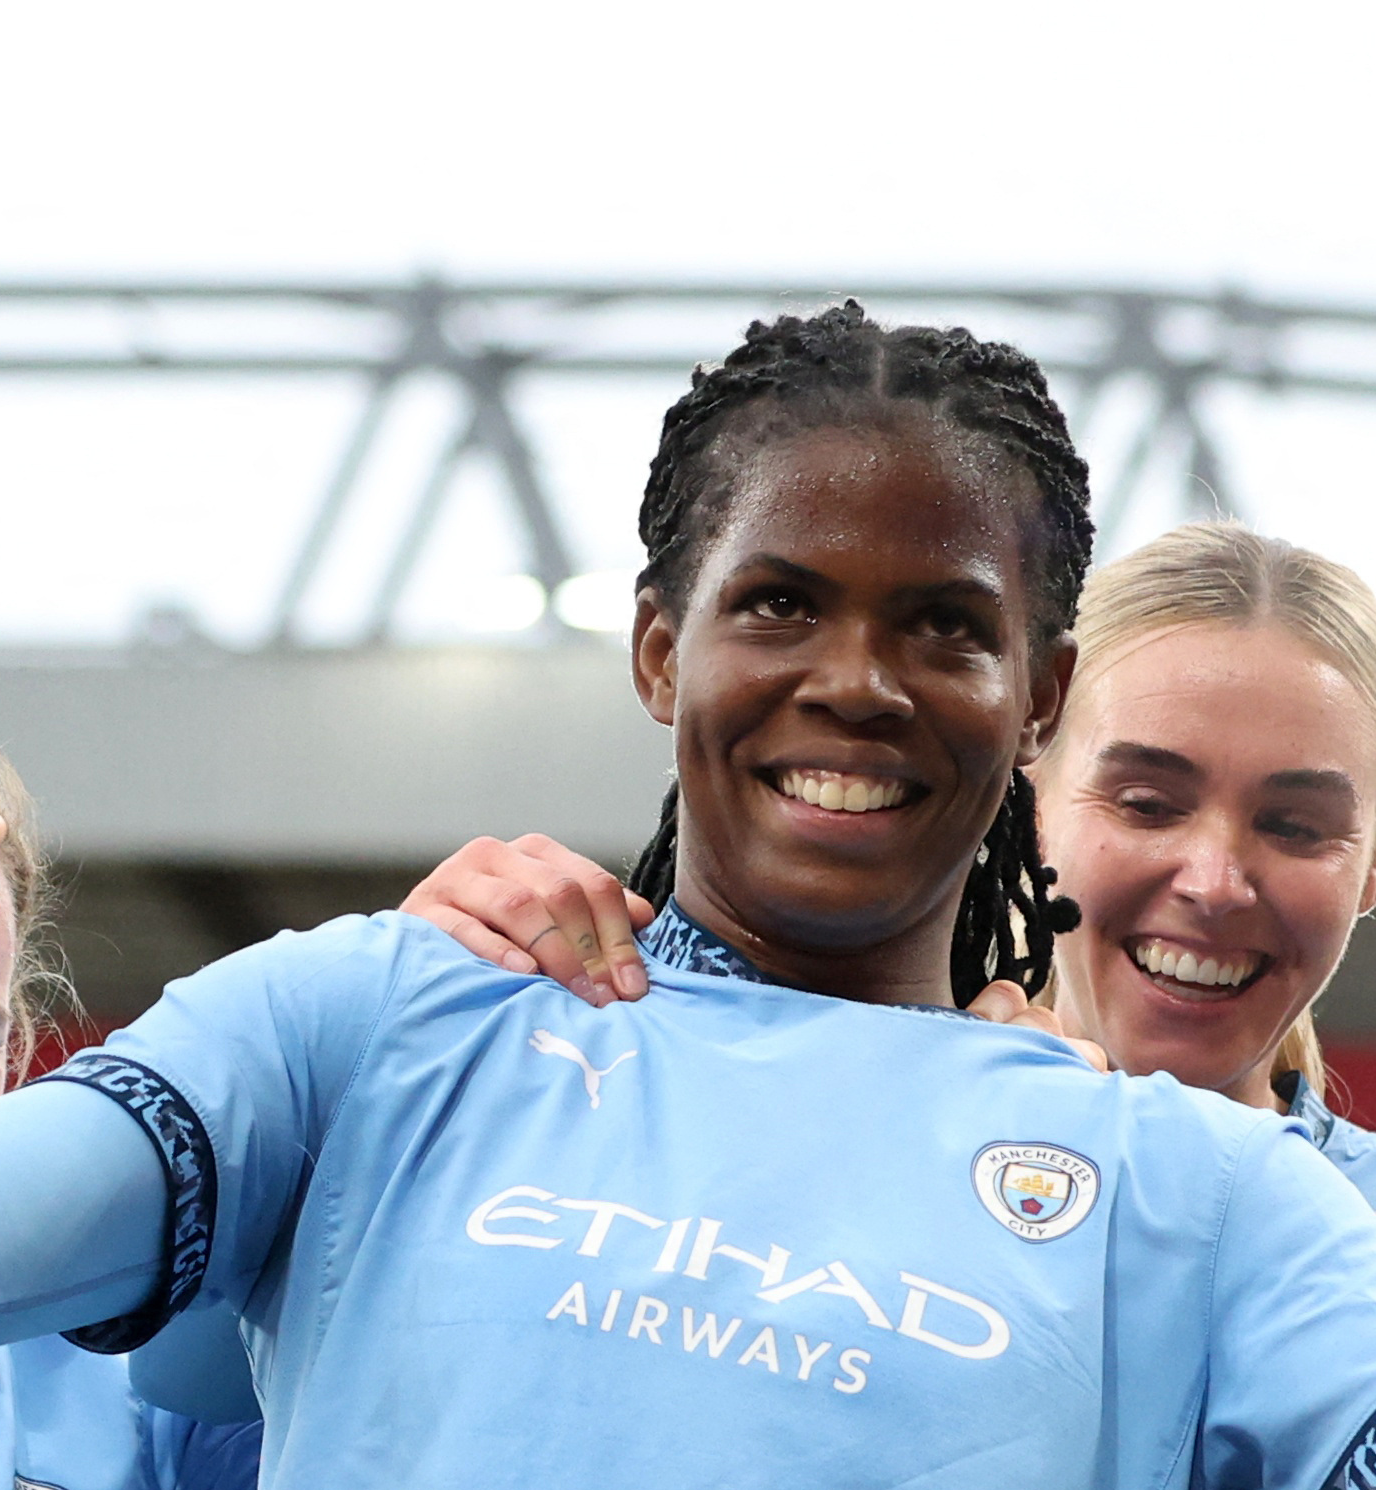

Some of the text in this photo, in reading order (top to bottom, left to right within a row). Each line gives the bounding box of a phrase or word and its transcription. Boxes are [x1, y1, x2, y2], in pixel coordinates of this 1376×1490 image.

[988, 1149, 1092, 1184] MANCHESTER
[1008, 1219, 1047, 1237] CITY
[465, 1185, 1011, 1360] ETIHAD
[545, 1281, 872, 1394] AIRWAYS
